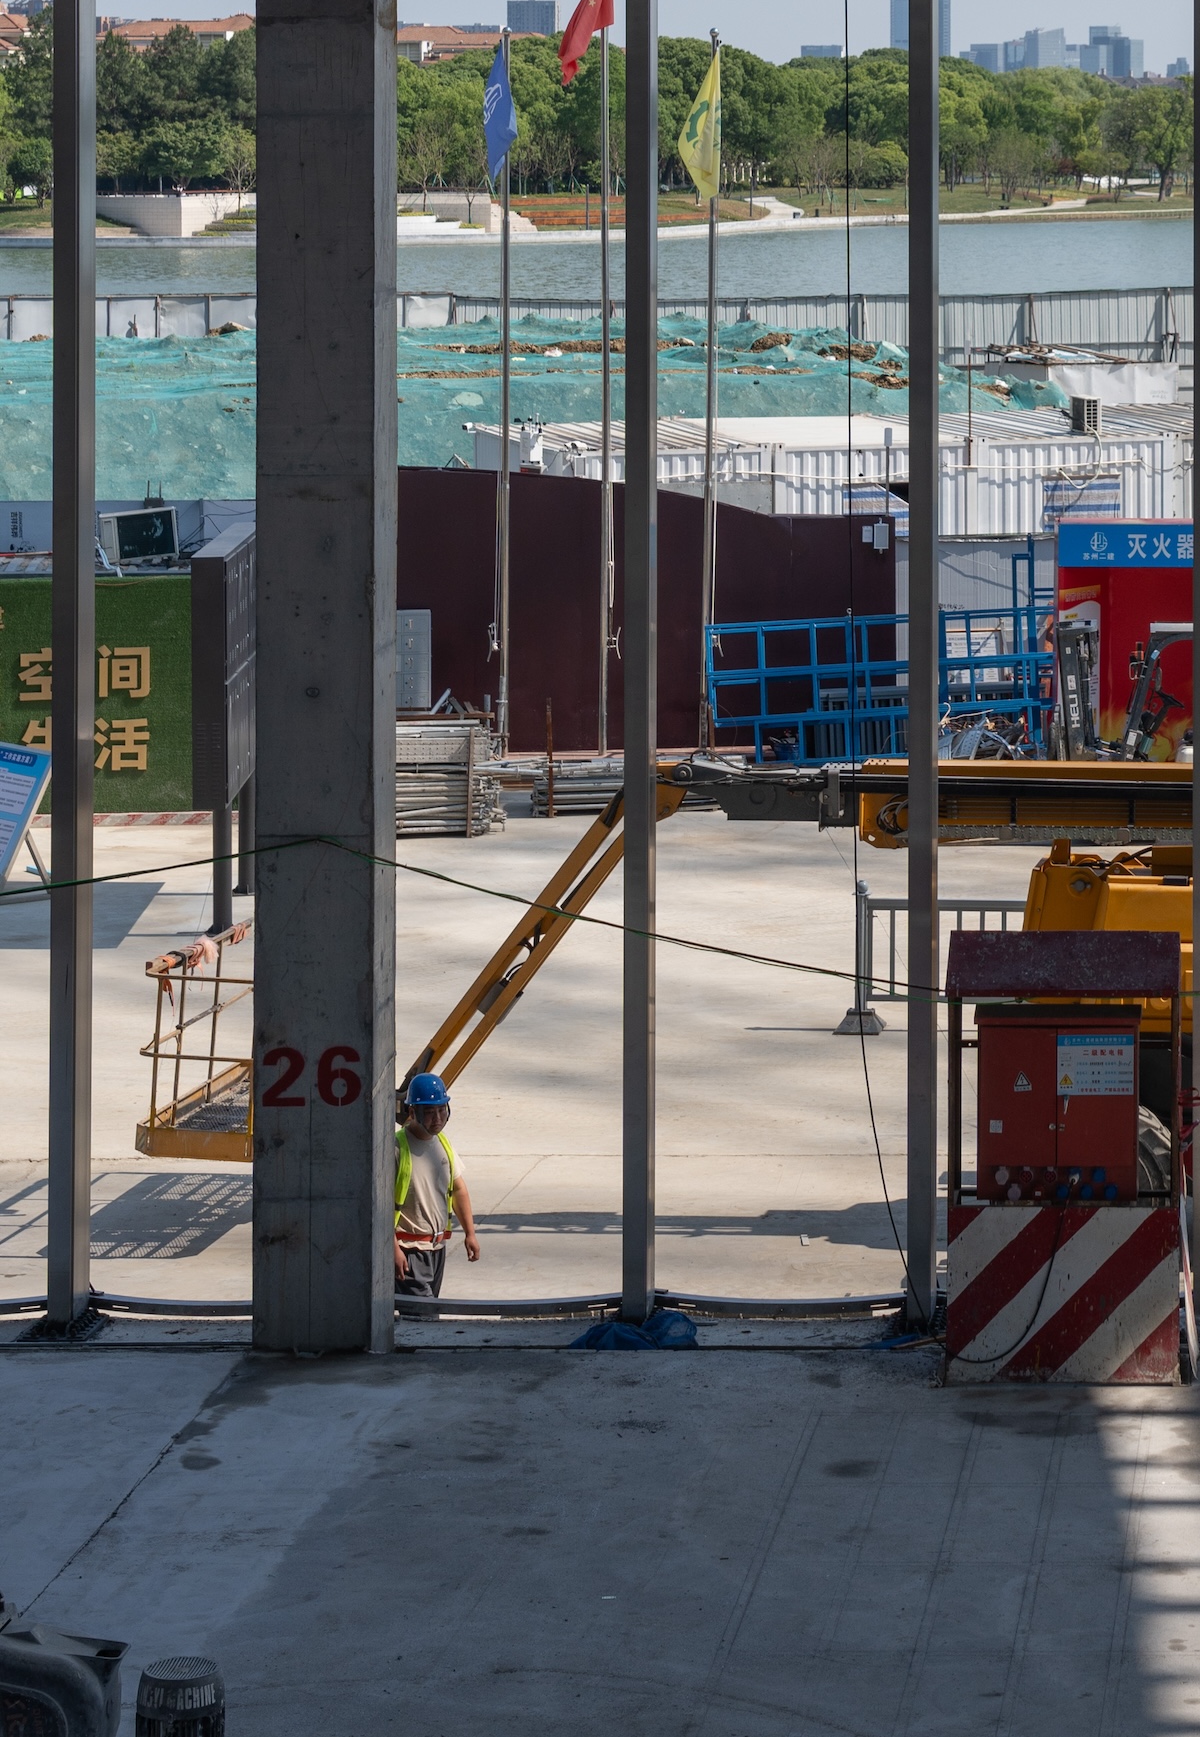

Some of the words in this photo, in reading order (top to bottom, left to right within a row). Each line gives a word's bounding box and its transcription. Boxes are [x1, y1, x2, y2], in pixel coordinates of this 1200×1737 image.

[1083, 552, 1115, 560] 苏州二建
[1069, 694, 1081, 728] HELI
[261, 1046, 362, 1108] 26
